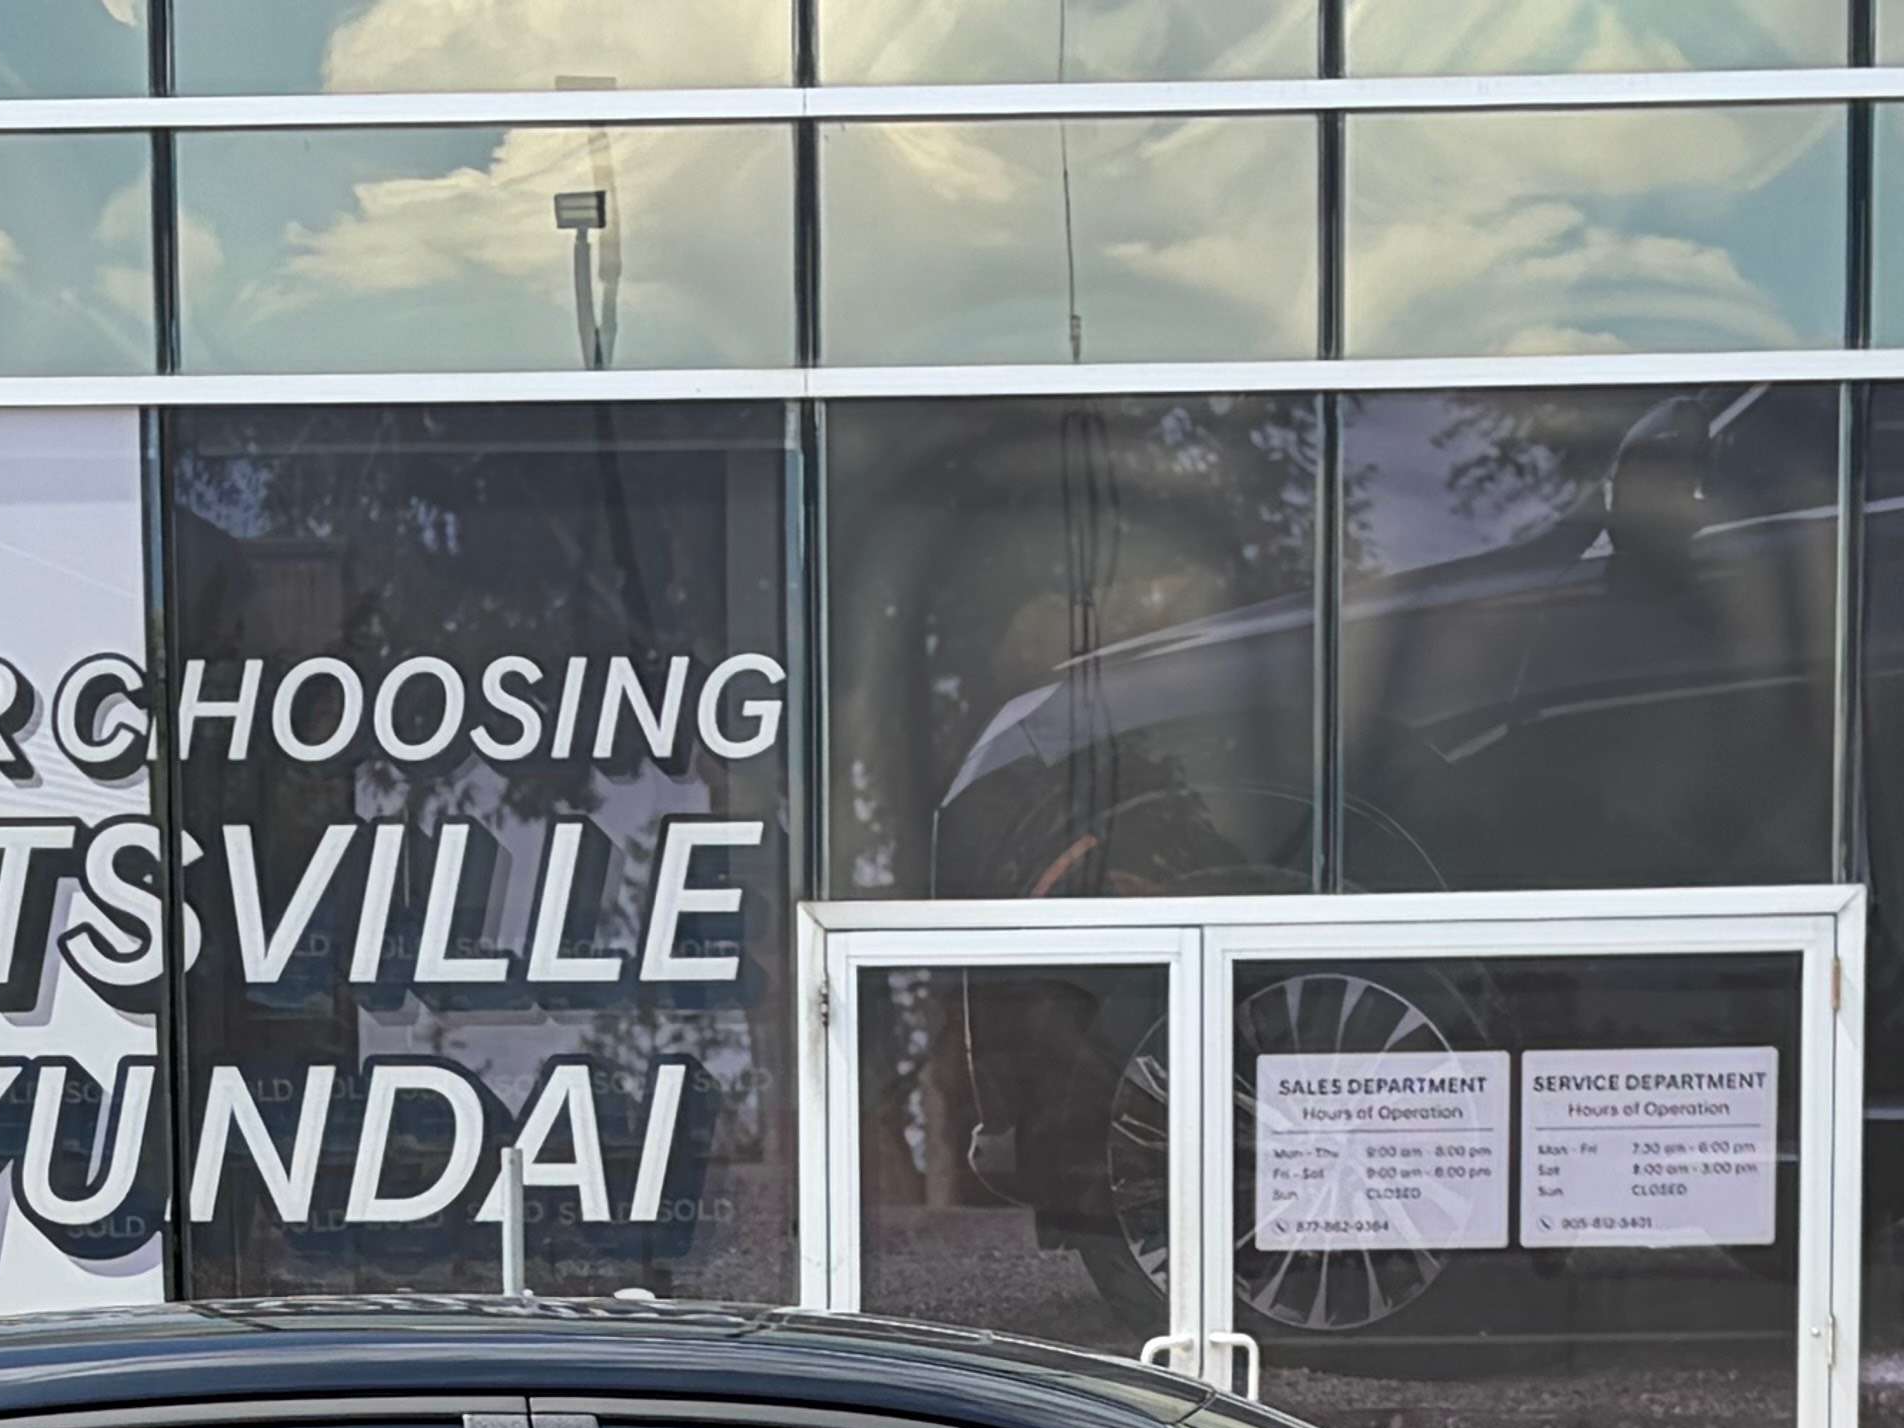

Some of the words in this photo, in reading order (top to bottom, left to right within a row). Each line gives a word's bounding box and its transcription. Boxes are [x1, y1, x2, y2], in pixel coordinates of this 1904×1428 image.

[52, 652, 786, 780] CHOOSING
[1279, 1078, 1343, 1096] SALES
[1347, 1076, 1488, 1095] DEPARTMENT
[1533, 1074, 1620, 1092] SERVICE
[1625, 1072, 1767, 1091] DEPARTMENT
[1303, 1106, 1352, 1121] Hours
[1356, 1105, 1373, 1120] of
[1378, 1105, 1463, 1123] Operation
[1568, 1103, 1618, 1117] Hours
[1622, 1102, 1639, 1116] of
[1644, 1101, 1730, 1118] Operation
[1365, 1187, 1421, 1200] CLOSED
[1631, 1183, 1688, 1197] CLOSED
